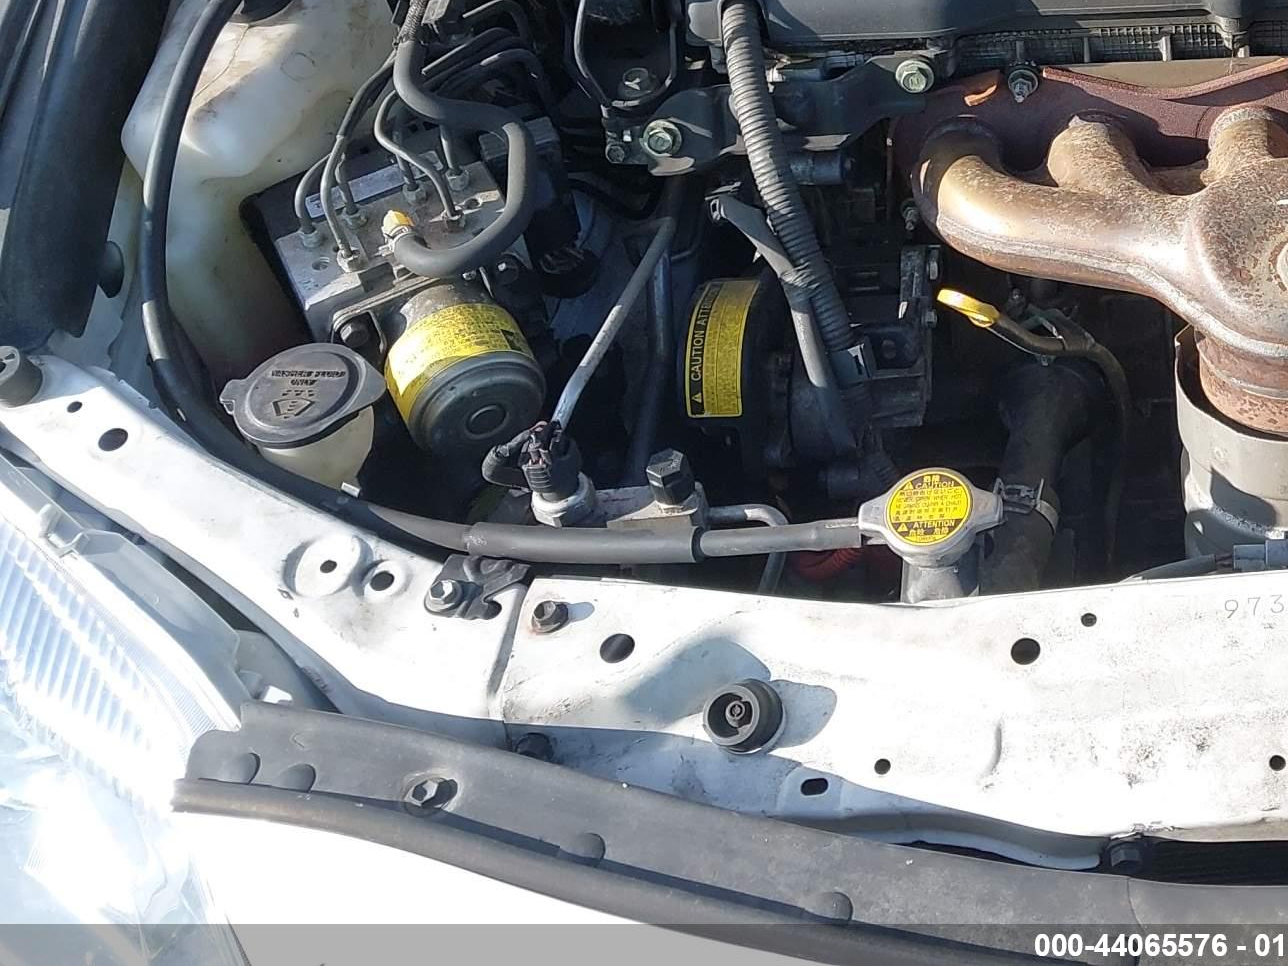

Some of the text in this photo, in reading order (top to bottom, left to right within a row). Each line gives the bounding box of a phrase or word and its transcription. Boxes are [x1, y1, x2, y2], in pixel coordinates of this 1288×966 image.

[691, 330, 705, 382] CAUTION
[915, 481, 955, 490] CAUTION
[913, 520, 955, 529] ATTENTION
